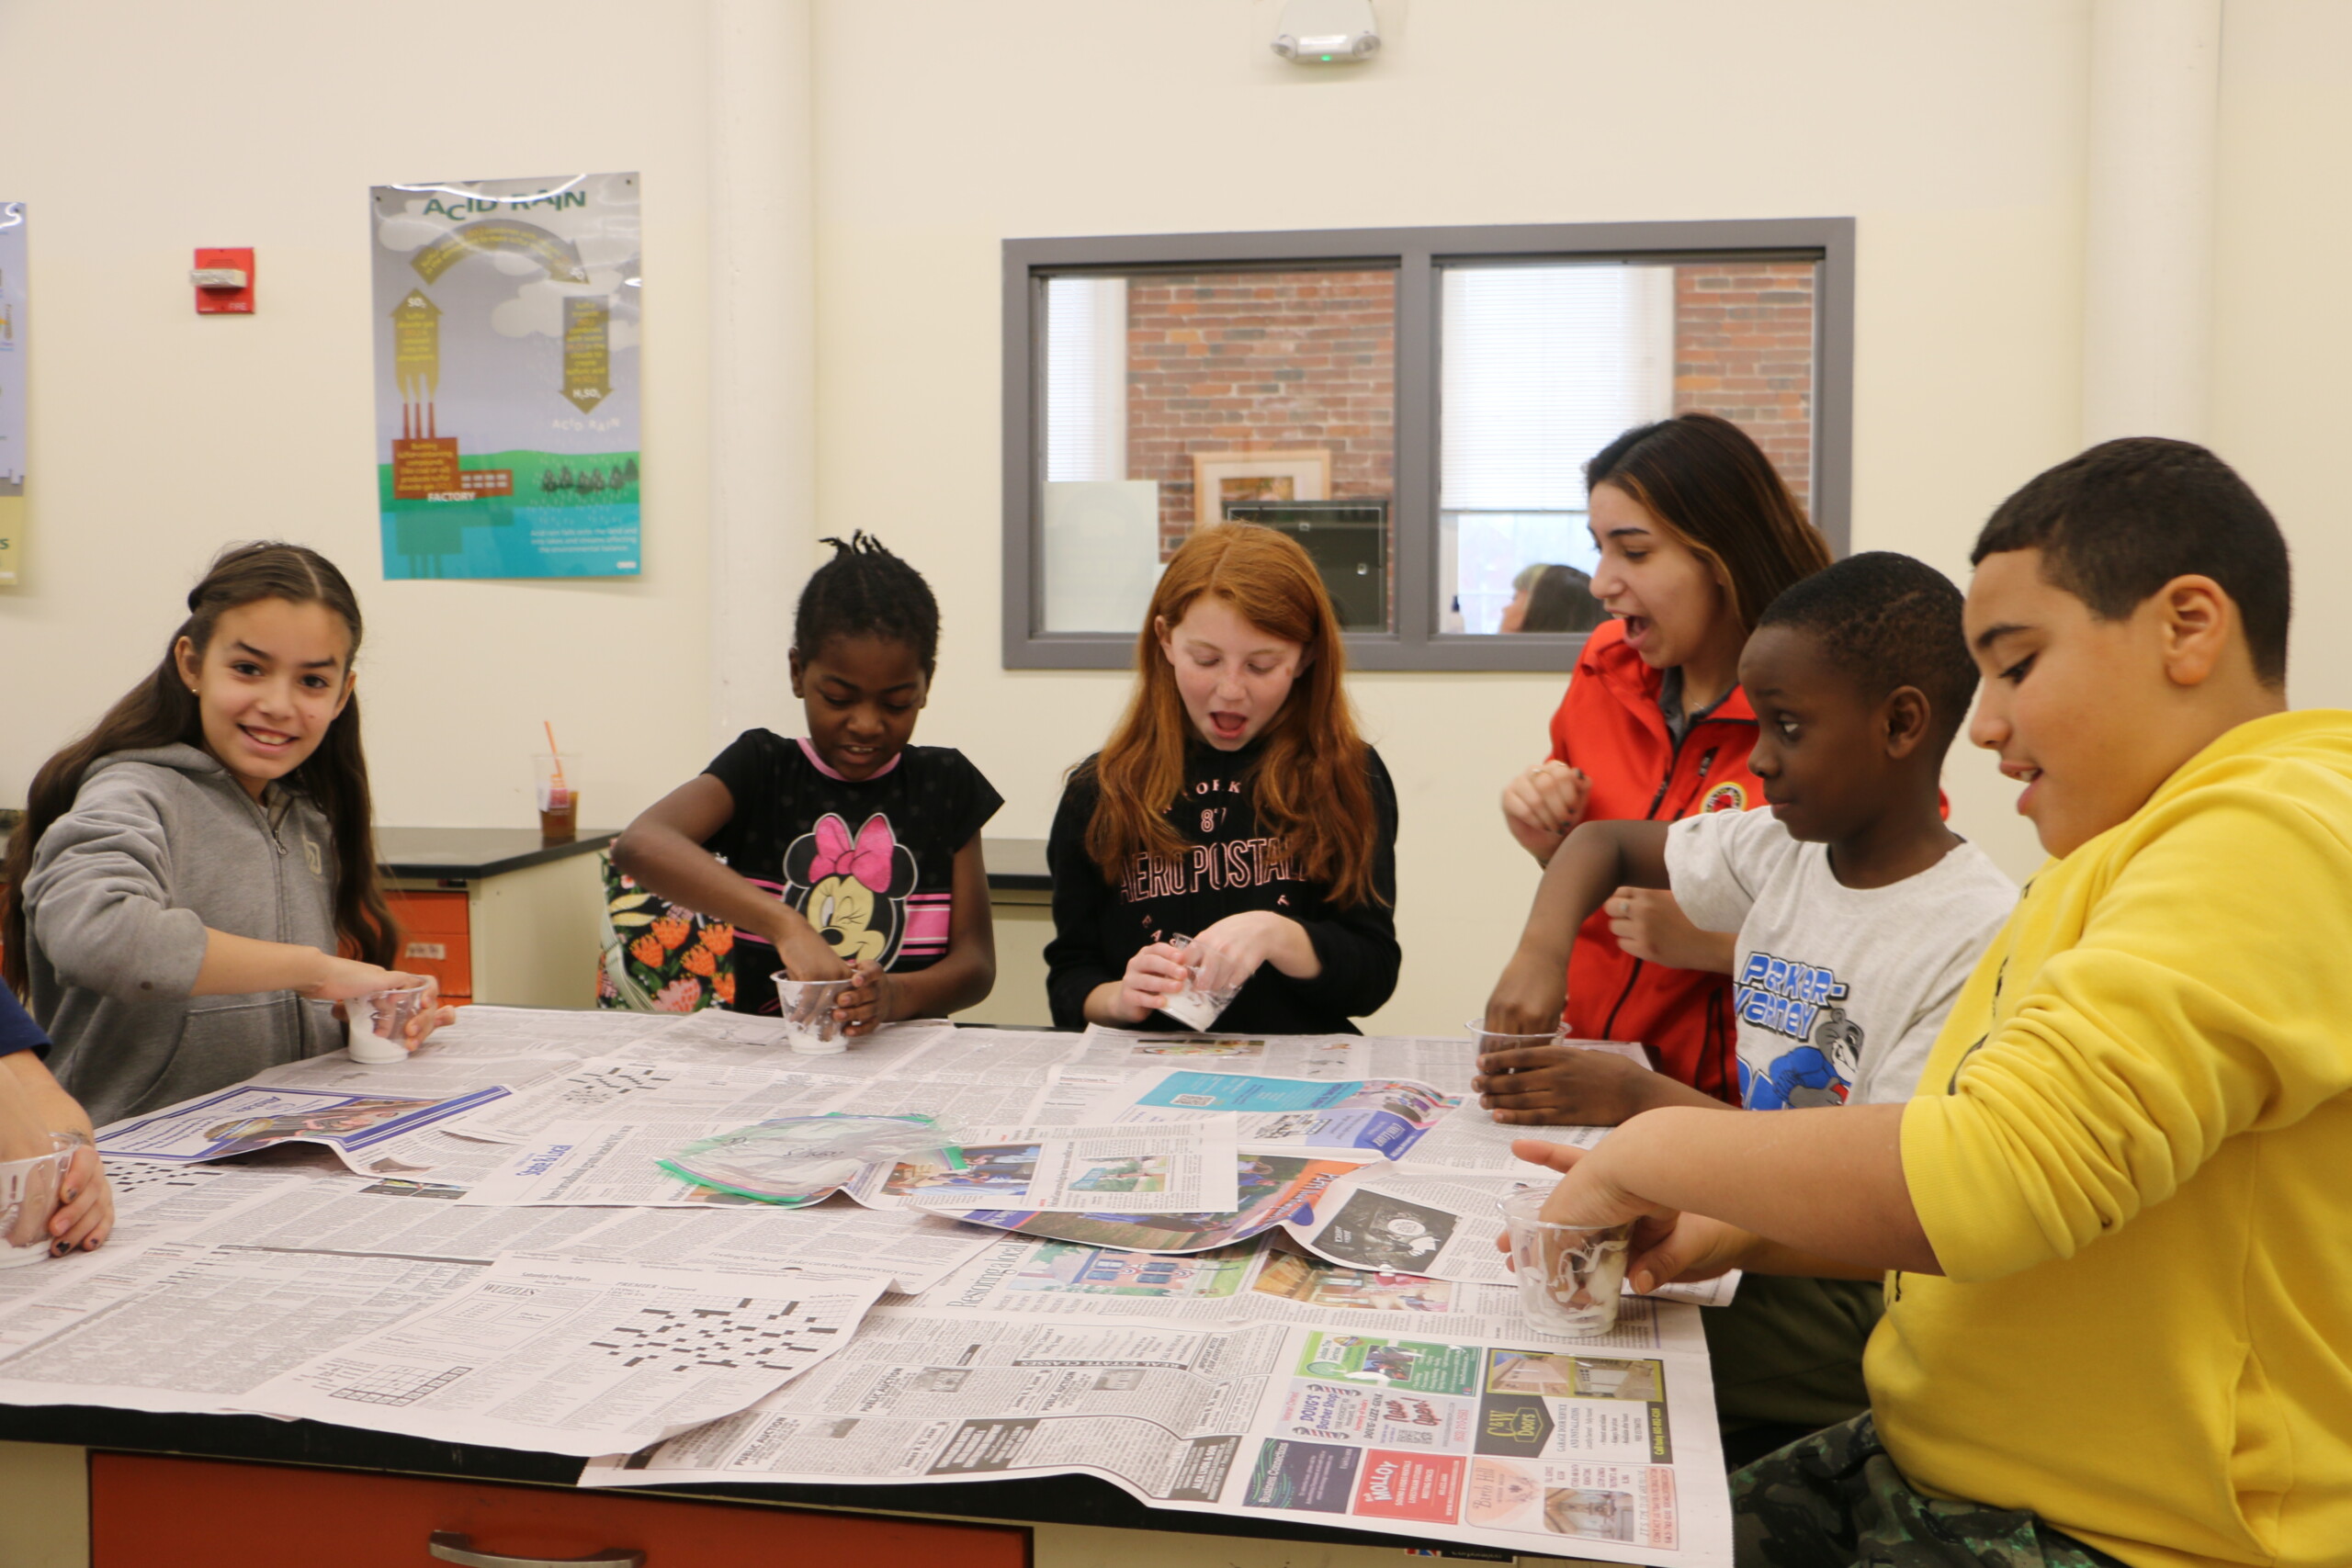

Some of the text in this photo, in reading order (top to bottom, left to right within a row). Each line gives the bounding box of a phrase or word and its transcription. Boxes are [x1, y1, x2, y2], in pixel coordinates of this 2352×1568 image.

[423, 189, 586, 220] ACID RAIN
[228, 301, 248, 311] FIRE
[427, 491, 476, 502] FACTORY
[1120, 838, 1307, 905] AEROPOSTAL
[482, 1282, 541, 1297] WUZZLES
[615, 1281, 659, 1290] PREMIER
[945, 1268, 1017, 1308] Restoring
[984, 1244, 1029, 1263] local
[859, 1367, 903, 1411] PUBLIC AUCTION
[1040, 1371, 1077, 1411] PUBLIC AUCTION
[1298, 1393, 1321, 1421] DOUG'S
[1315, 1393, 1340, 1429] Barber Shop
[1383, 1398, 1407, 1425] Now
[1413, 1396, 1443, 1428] Open!
[1486, 1409, 1520, 1437] C&W
[735, 1416, 787, 1465] PUBLIC AUCTION
[1518, 1413, 1535, 1436] Doors
[1257, 1441, 1289, 1503] Business Connections
[1373, 1461, 1399, 1503] MOLLOY
[1472, 1466, 1495, 1509] Birch Hill
